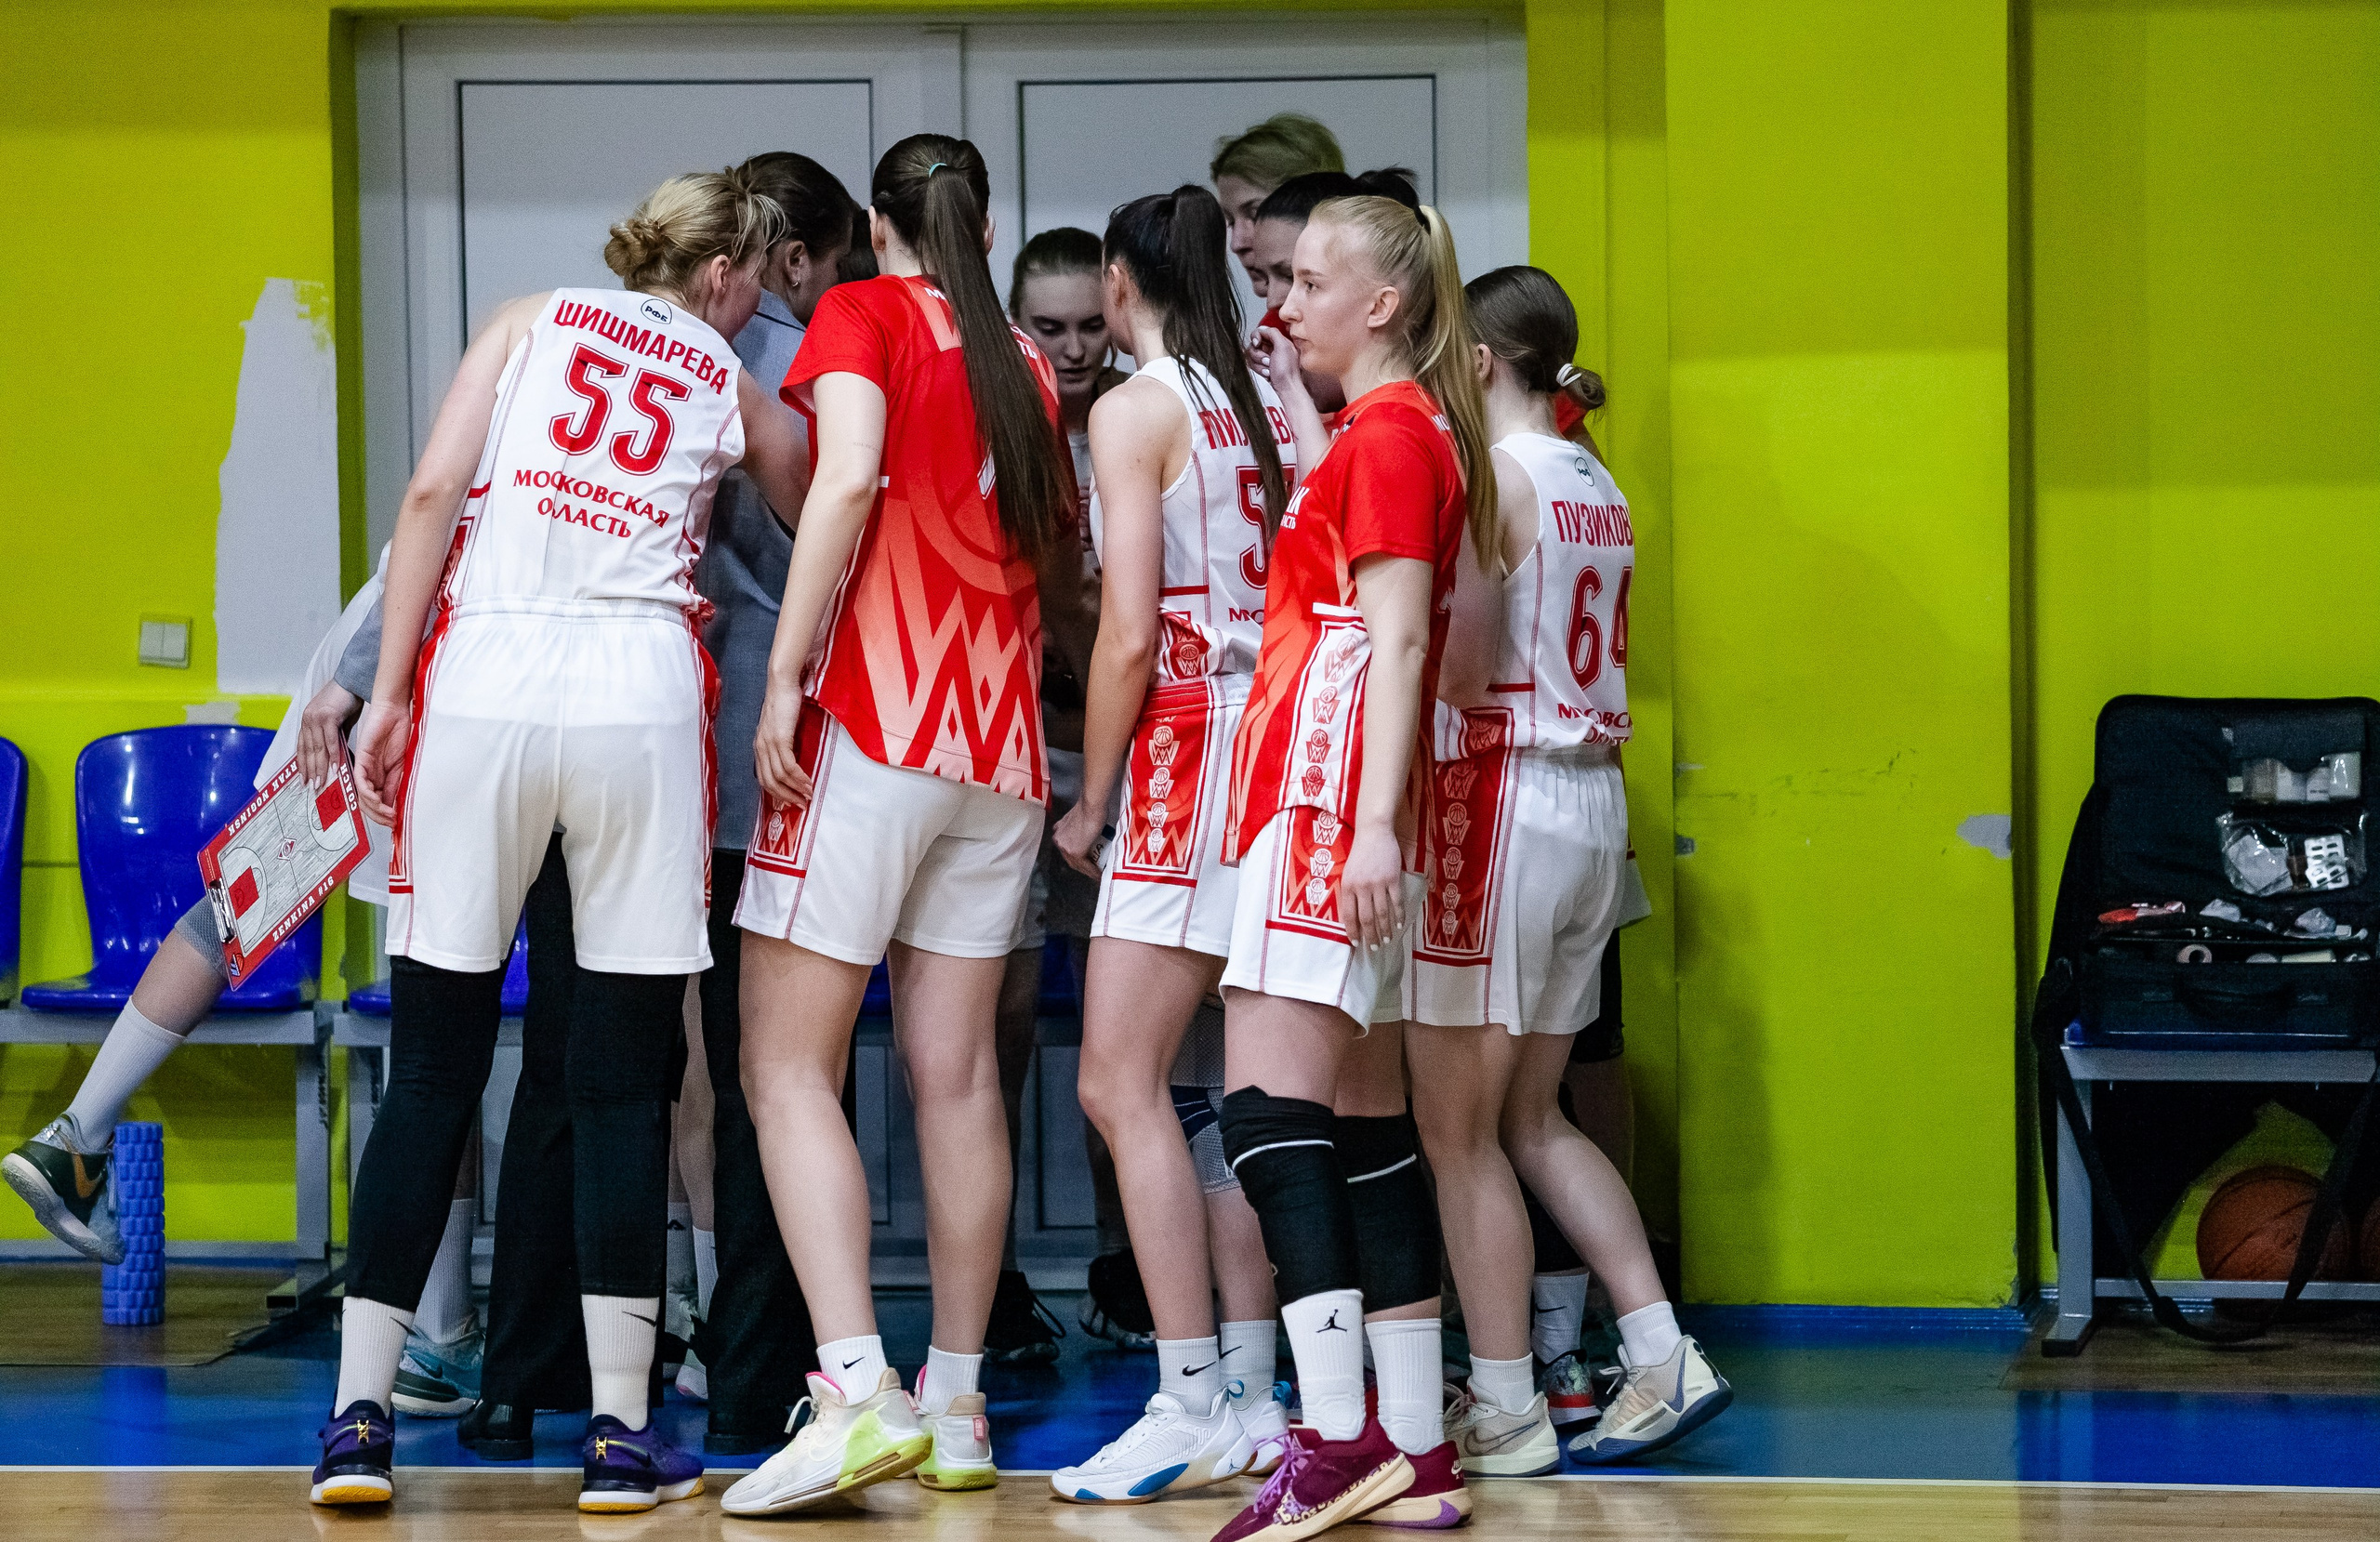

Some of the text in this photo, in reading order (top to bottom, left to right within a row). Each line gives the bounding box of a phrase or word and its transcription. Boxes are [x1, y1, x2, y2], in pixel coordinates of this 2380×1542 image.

[644, 305, 668, 323] РФБ
[553, 299, 729, 396] ШИШМАРЕВА
[549, 342, 693, 476] 55
[512, 469, 670, 529] МОСКОВСКАЯ
[537, 497, 632, 538] ОЛАСТЬ
[1566, 565, 1633, 692] 64
[228, 760, 298, 837] RTAK NOGINSK
[340, 763, 357, 811] COACH
[272, 876, 335, 942] ZENKINA #16
